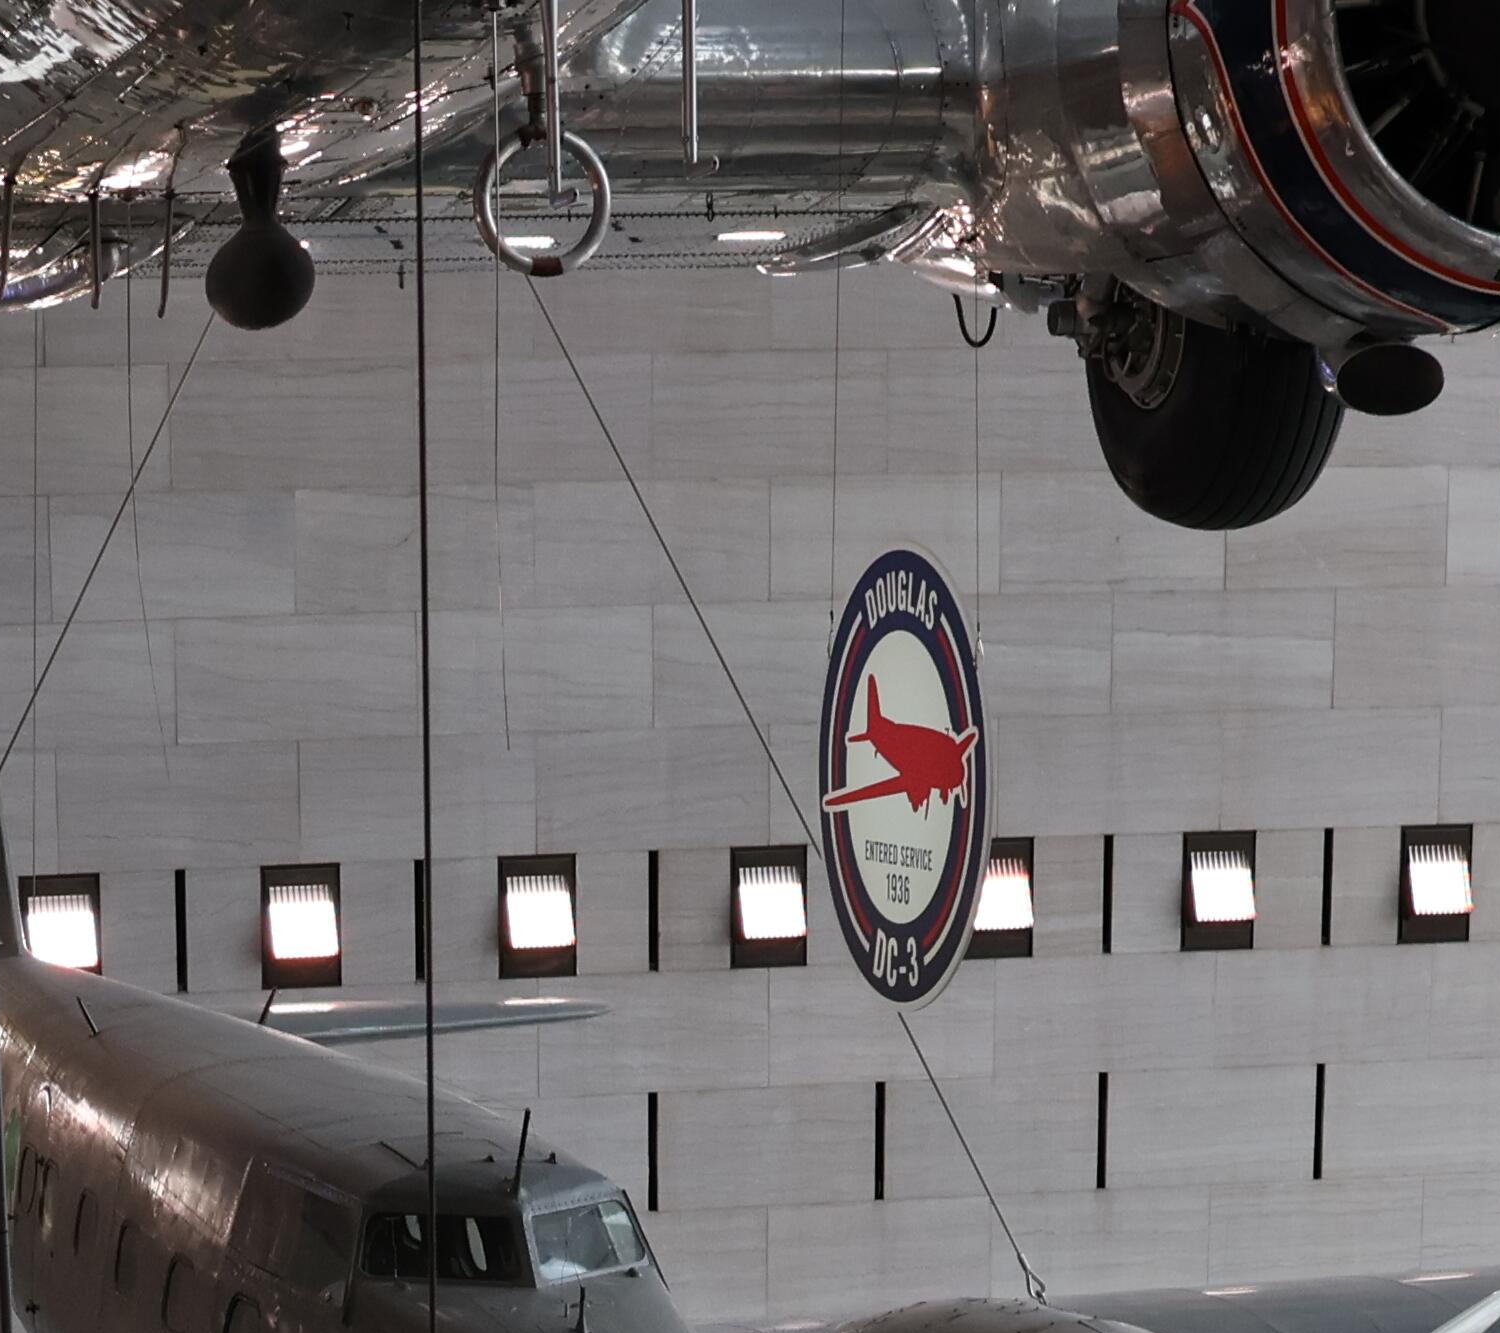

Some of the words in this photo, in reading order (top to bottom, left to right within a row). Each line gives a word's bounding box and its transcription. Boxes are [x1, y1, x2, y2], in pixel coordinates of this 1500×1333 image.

[865, 570, 938, 631] DOUGLAS
[864, 839, 899, 867] ENTERED
[900, 844, 933, 872] SERVICE
[885, 873, 911, 906] 1936
[872, 927, 920, 989] DC-3
